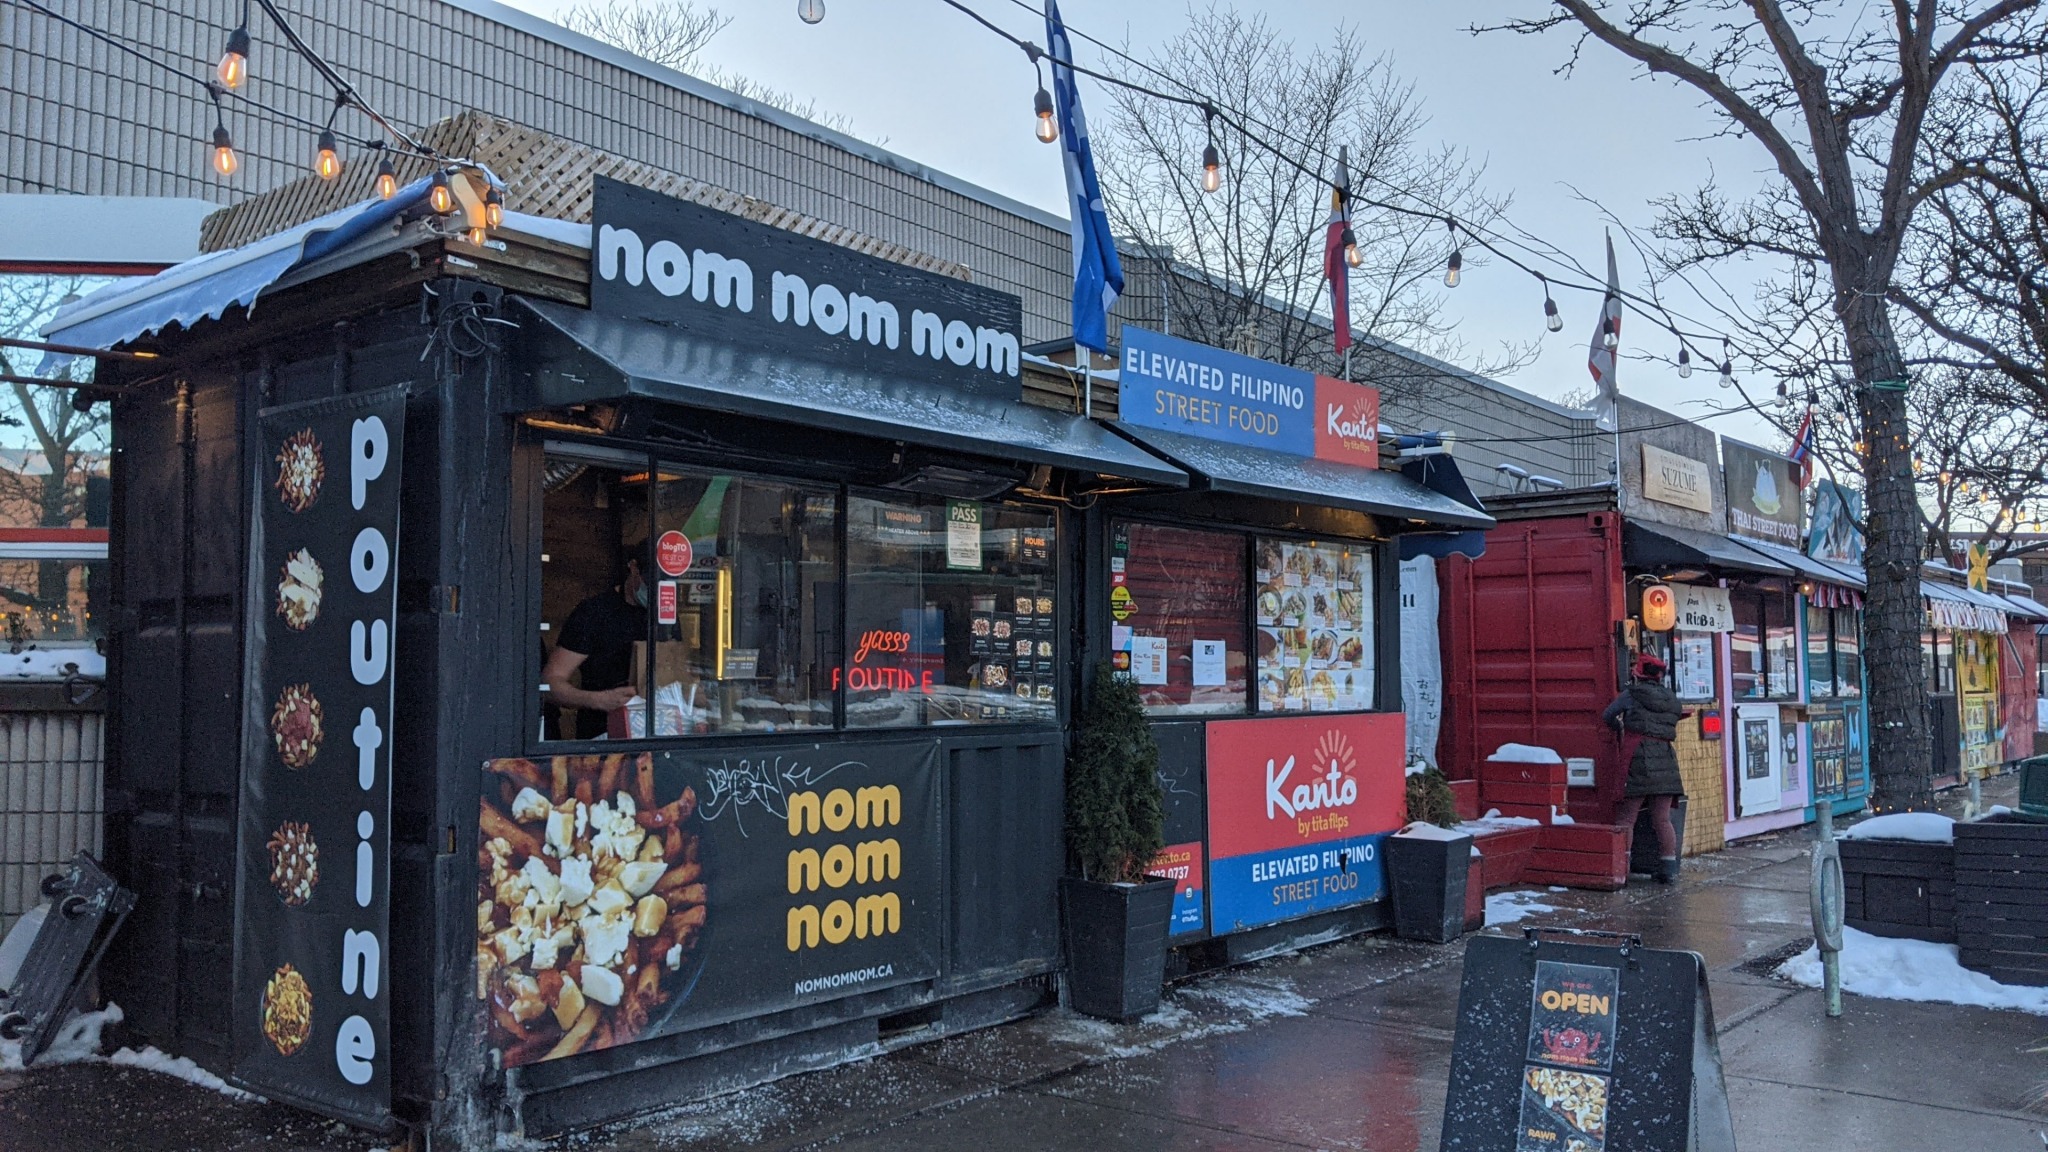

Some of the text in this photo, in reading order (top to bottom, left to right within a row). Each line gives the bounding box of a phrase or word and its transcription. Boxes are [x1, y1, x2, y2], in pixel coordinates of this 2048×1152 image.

[599, 224, 1020, 377] nom nom nom
[1126, 346, 1304, 410] ELEVATED FILIPINO
[1155, 389, 1279, 436] STREET FOOD
[1327, 402, 1375, 441] Kanto
[1661, 466, 1697, 492] SUZUME
[885, 511, 922, 523] WARNING
[951, 506, 977, 522] PASS
[1731, 506, 1798, 540] THAI STREET FOOD
[662, 542, 687, 552] blogTO
[1024, 537, 1045, 547] HOURS
[854, 630, 911, 663] yasss
[335, 415, 390, 1086] poutine
[1266, 754, 1357, 820] Kanto
[788, 784, 900, 837] nom
[1298, 817, 1310, 838] by
[787, 838, 900, 894] nom
[1252, 855, 1319, 883] ELEVATED
[1272, 871, 1358, 906] STREET FOOD
[787, 891, 900, 952] nom
[795, 964, 893, 995] NOMNOMNOM.CA
[1541, 990, 1610, 1016] OPEN
[1527, 1128, 1557, 1141] RAWR
